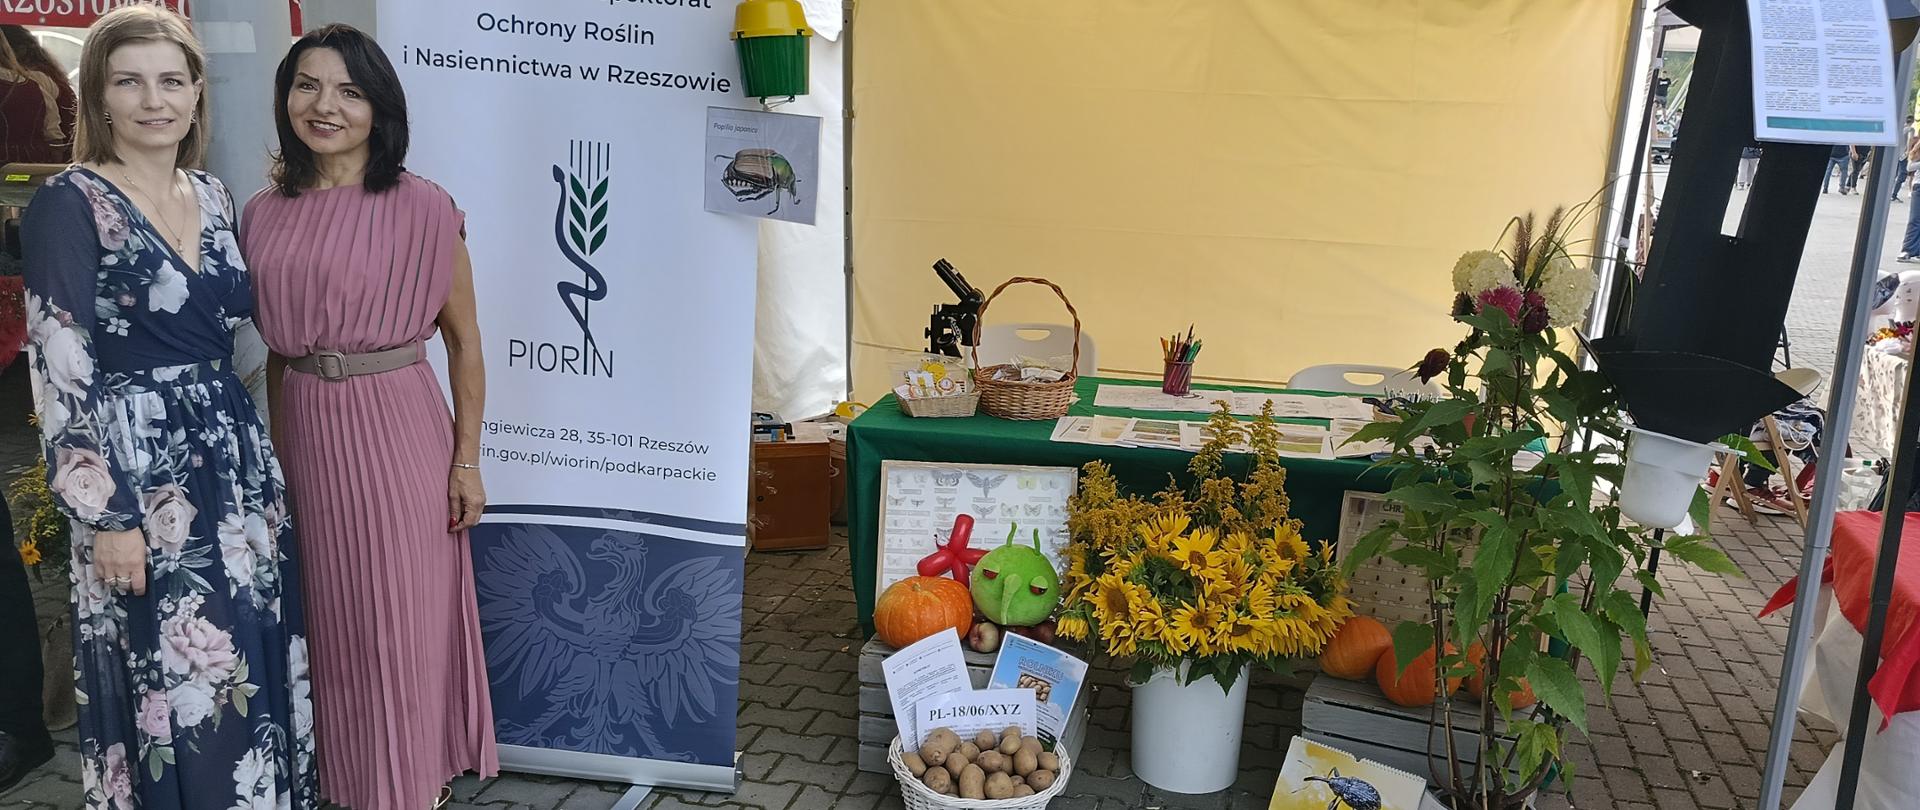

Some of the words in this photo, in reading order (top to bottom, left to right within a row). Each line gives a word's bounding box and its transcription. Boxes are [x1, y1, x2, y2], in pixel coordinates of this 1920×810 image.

[477, 13, 577, 43] Ochrony
[585, 21, 654, 45] Roślin
[403, 45, 408, 65] i
[416, 48, 572, 79] Nasiennictwa
[579, 64, 600, 81] w
[608, 65, 731, 93] Rzeszowie
[509, 339, 613, 378] PIORIN
[560, 429, 583, 444] 28,
[587, 431, 633, 448] 35-101
[639, 437, 709, 455] Rzeszów
[480, 443, 717, 482] in.gov.pl/wiorin/podkarpackie
[929, 704, 1021, 721] PL-18/06/XYZ
